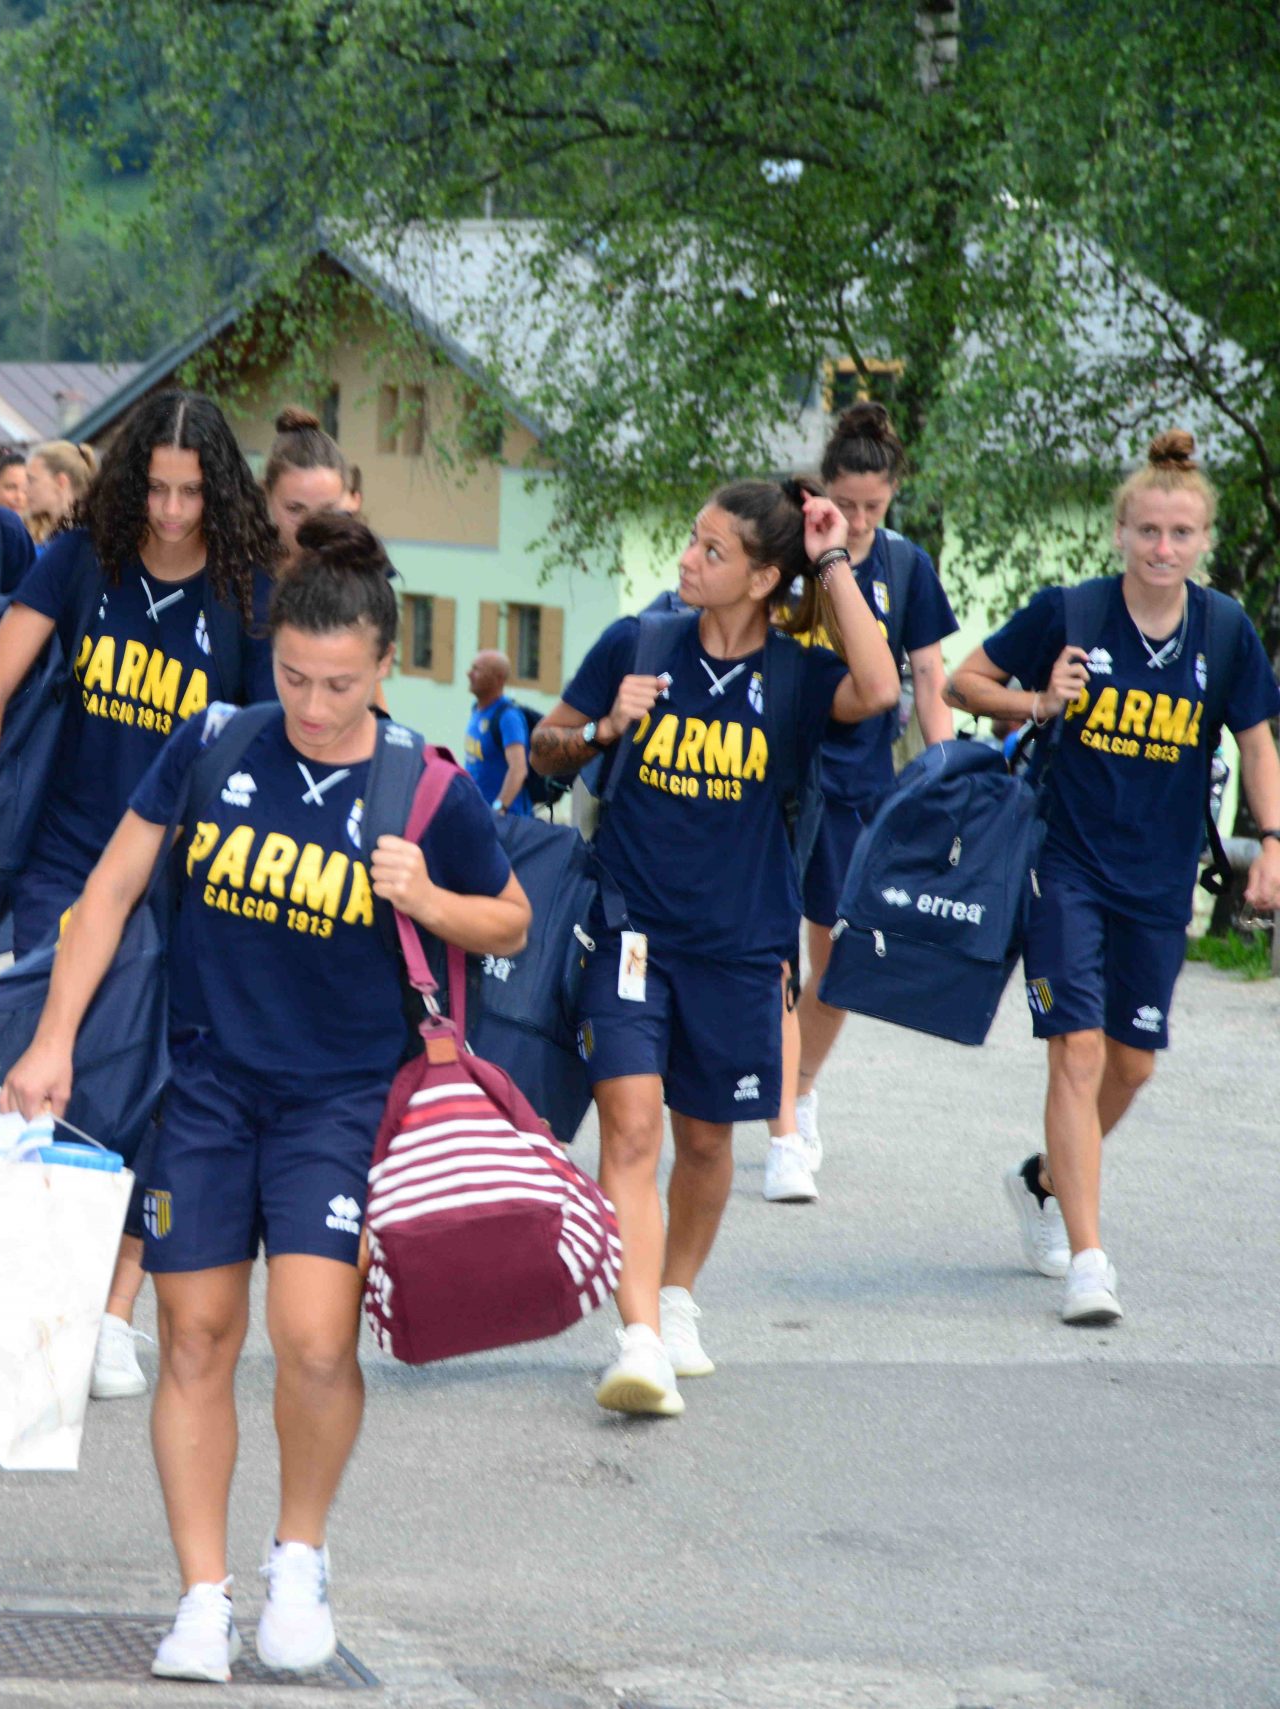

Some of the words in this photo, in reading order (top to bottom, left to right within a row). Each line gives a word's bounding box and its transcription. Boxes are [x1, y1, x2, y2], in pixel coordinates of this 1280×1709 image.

[136, 706, 172, 736] 1913
[1080, 729, 1140, 759] CALCIO
[1144, 743, 1181, 763] 1913
[639, 764, 699, 798] CALCIO
[706, 778, 742, 801] 1913
[186, 820, 375, 927] PARMA
[203, 884, 279, 924] CALCIO
[287, 908, 334, 938] 1913
